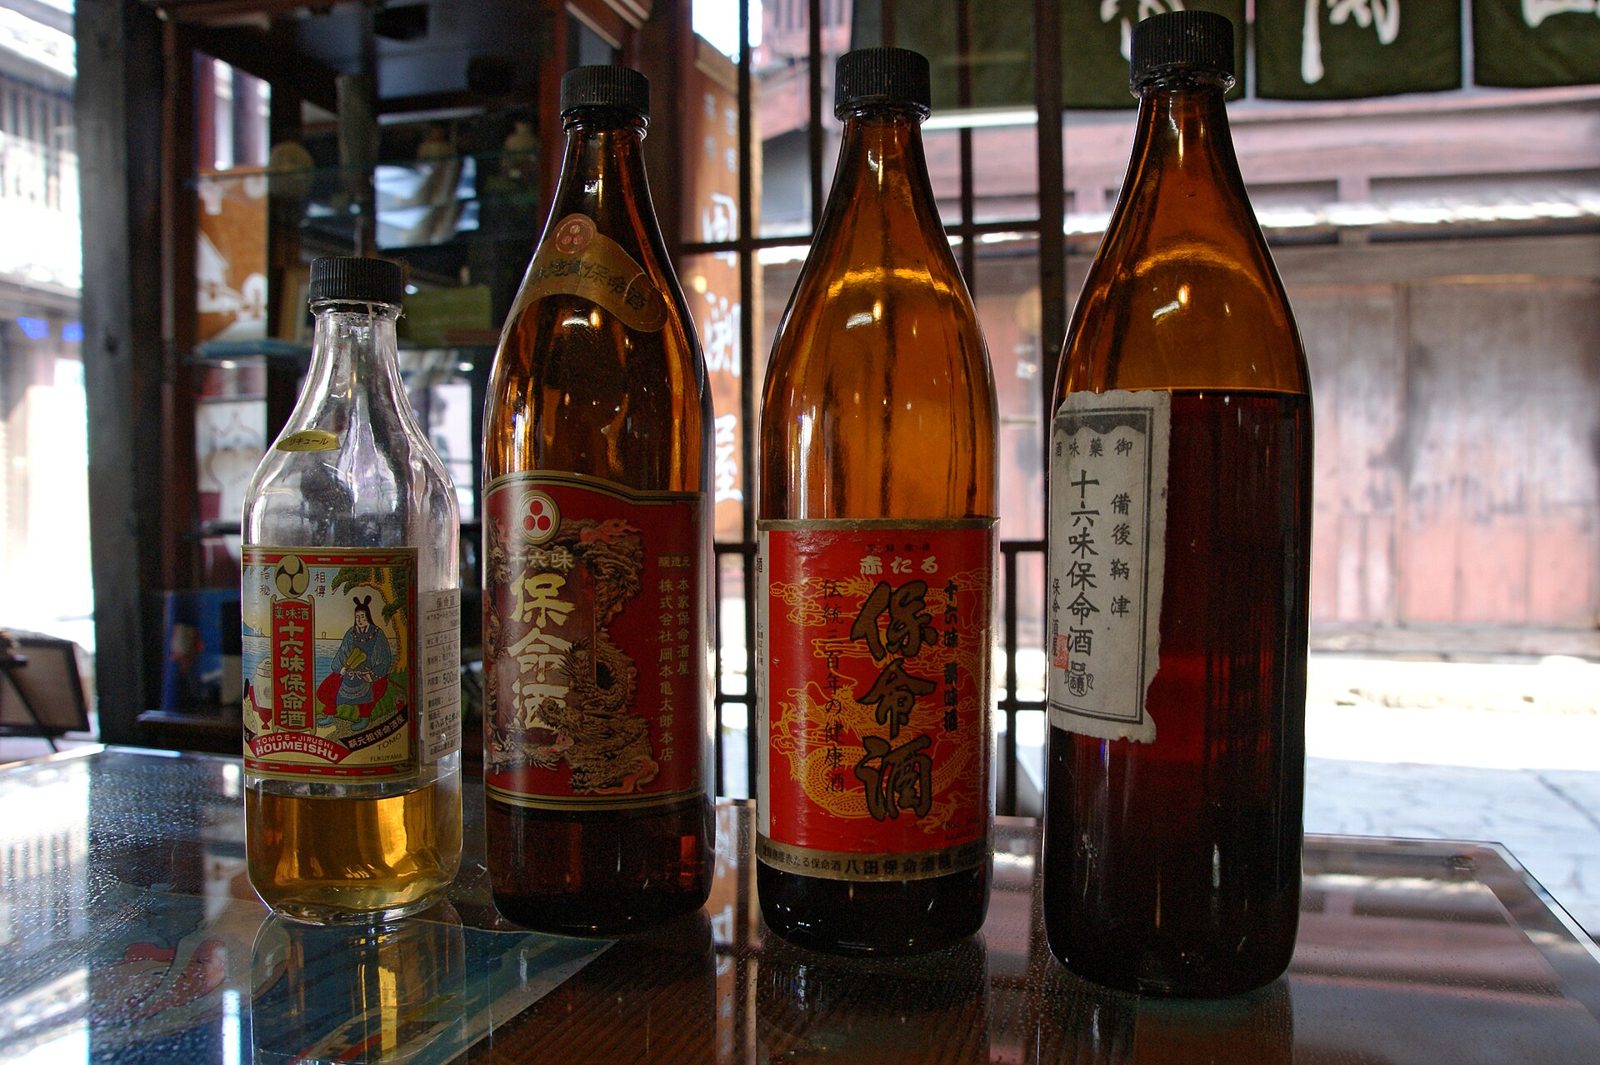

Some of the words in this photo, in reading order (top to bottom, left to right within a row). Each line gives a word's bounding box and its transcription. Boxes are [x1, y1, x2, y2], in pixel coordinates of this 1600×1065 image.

[288, 437, 329, 446] リキュール
[859, 555, 939, 576] 赤たる
[1066, 469, 1100, 656] 十六味保命酒
[1109, 492, 1133, 618] 備後鞆津
[507, 570, 576, 730] 保命酒
[278, 621, 306, 727] 十六味保命酒
[255, 740, 339, 762] HOUMEISHU
[256, 734, 334, 750] TOMOE-JIRUSHI
[377, 732, 402, 751] TOMO
[370, 753, 403, 763] FUKUYAMA
